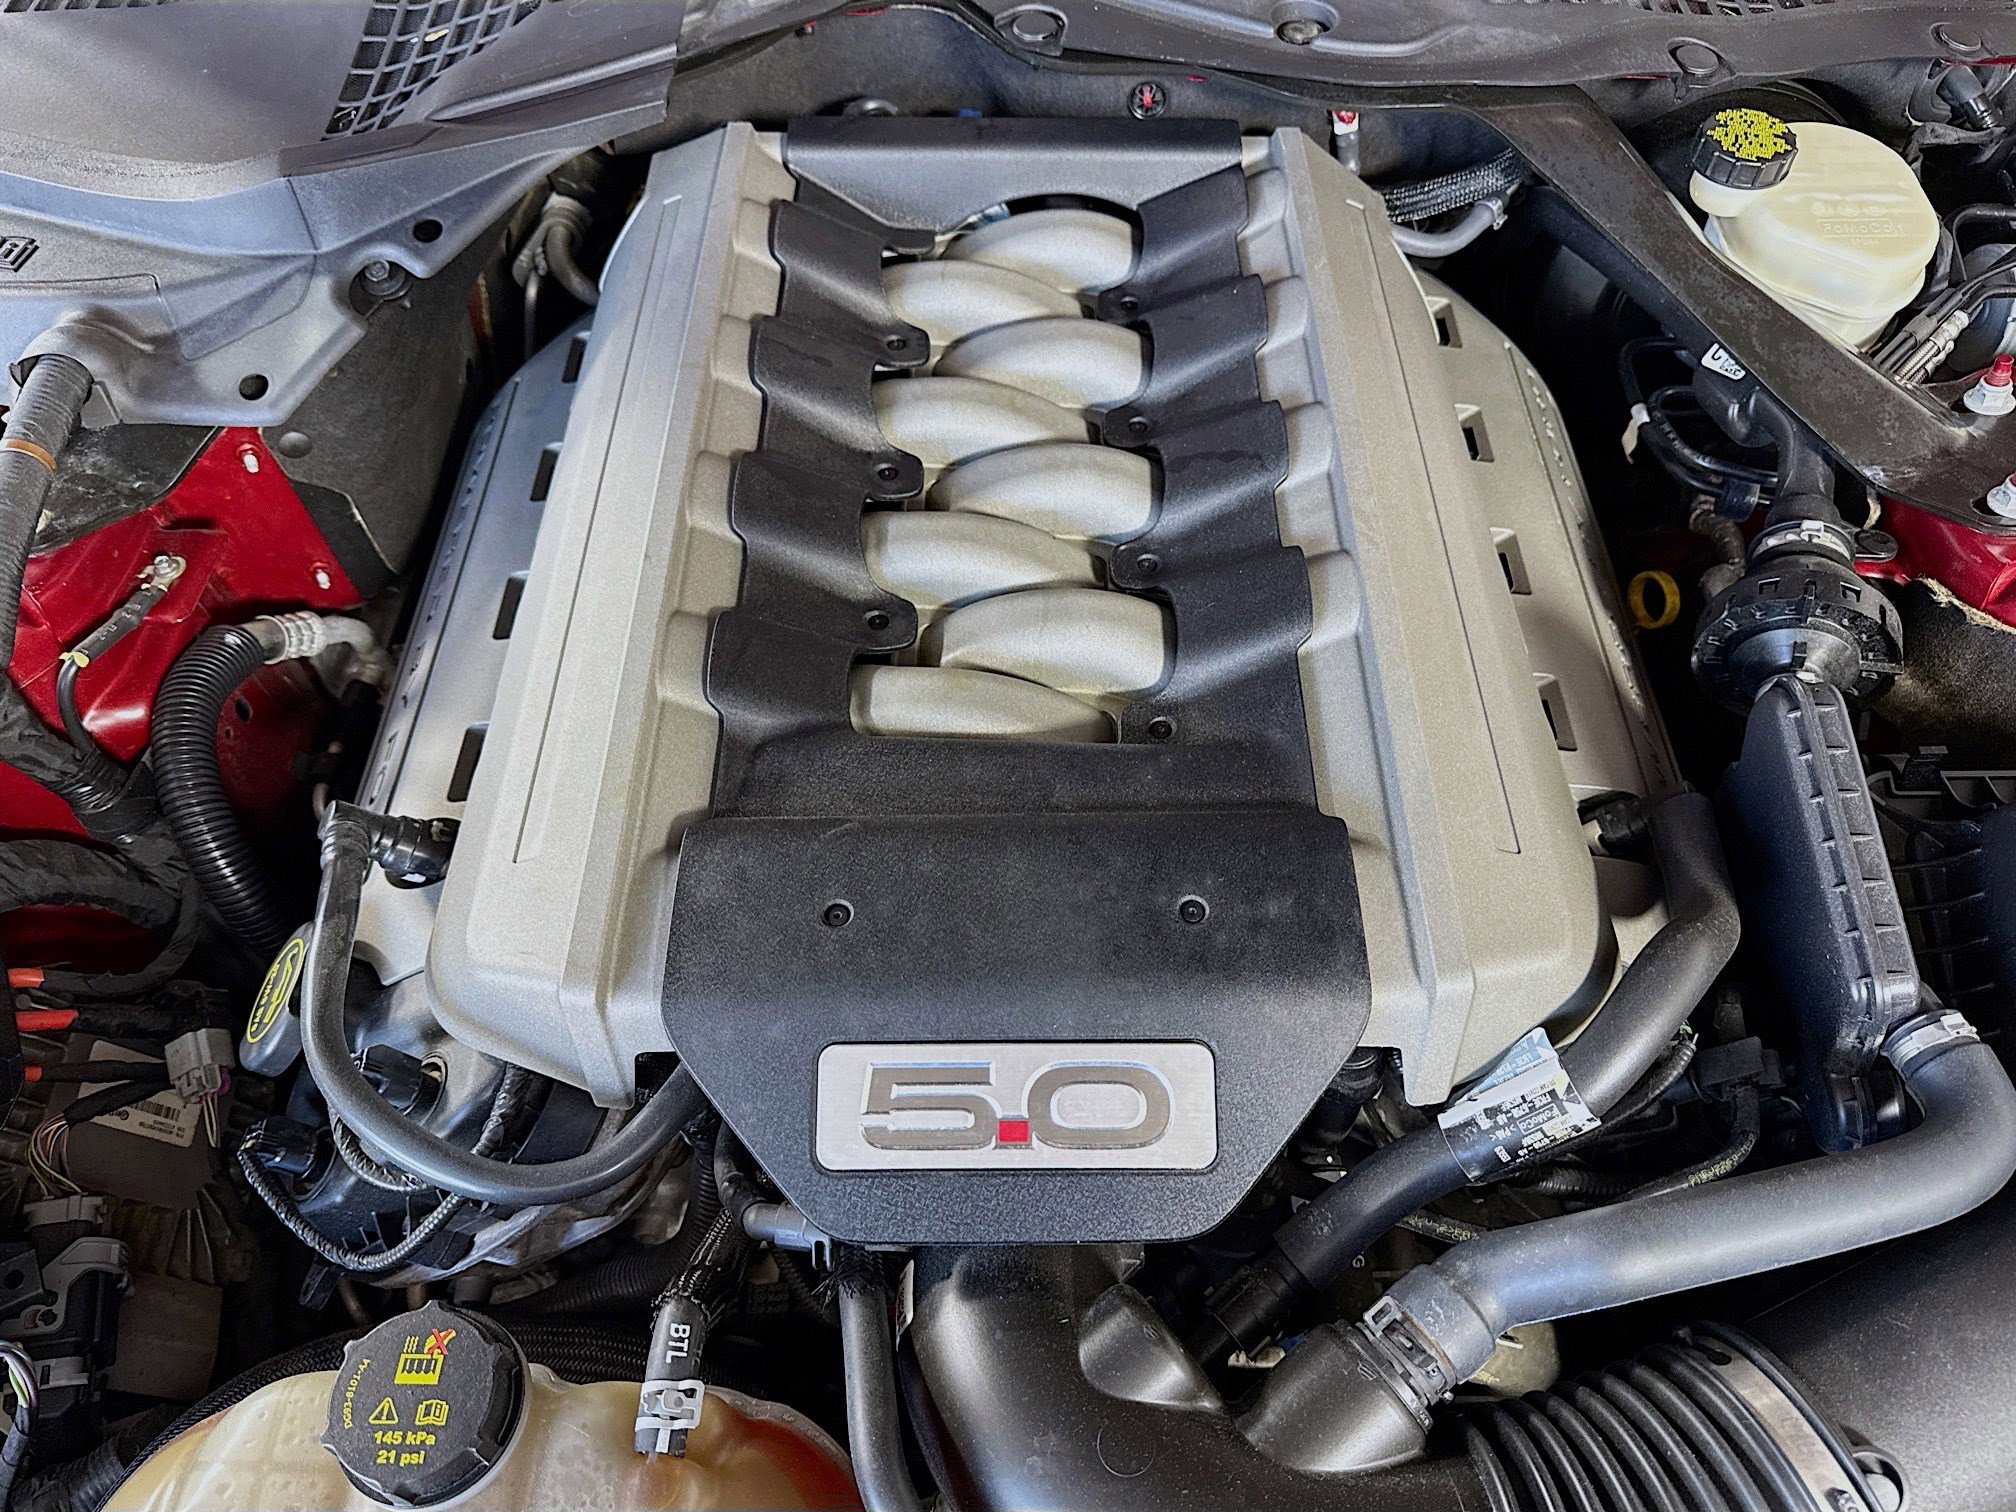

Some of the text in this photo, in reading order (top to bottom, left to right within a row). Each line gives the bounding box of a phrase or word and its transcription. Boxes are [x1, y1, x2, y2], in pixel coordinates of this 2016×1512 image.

[1822, 222, 1892, 234] FoMoCo
[858, 1060, 1177, 1150] 5.0
[1520, 1106, 1559, 1129] FoMoCo
[665, 1322, 691, 1364] BTL
[343, 1357, 371, 1430] DG93-8101-AA
[374, 1430, 437, 1446] 145 kPa
[376, 1449, 426, 1467] 21 psi
